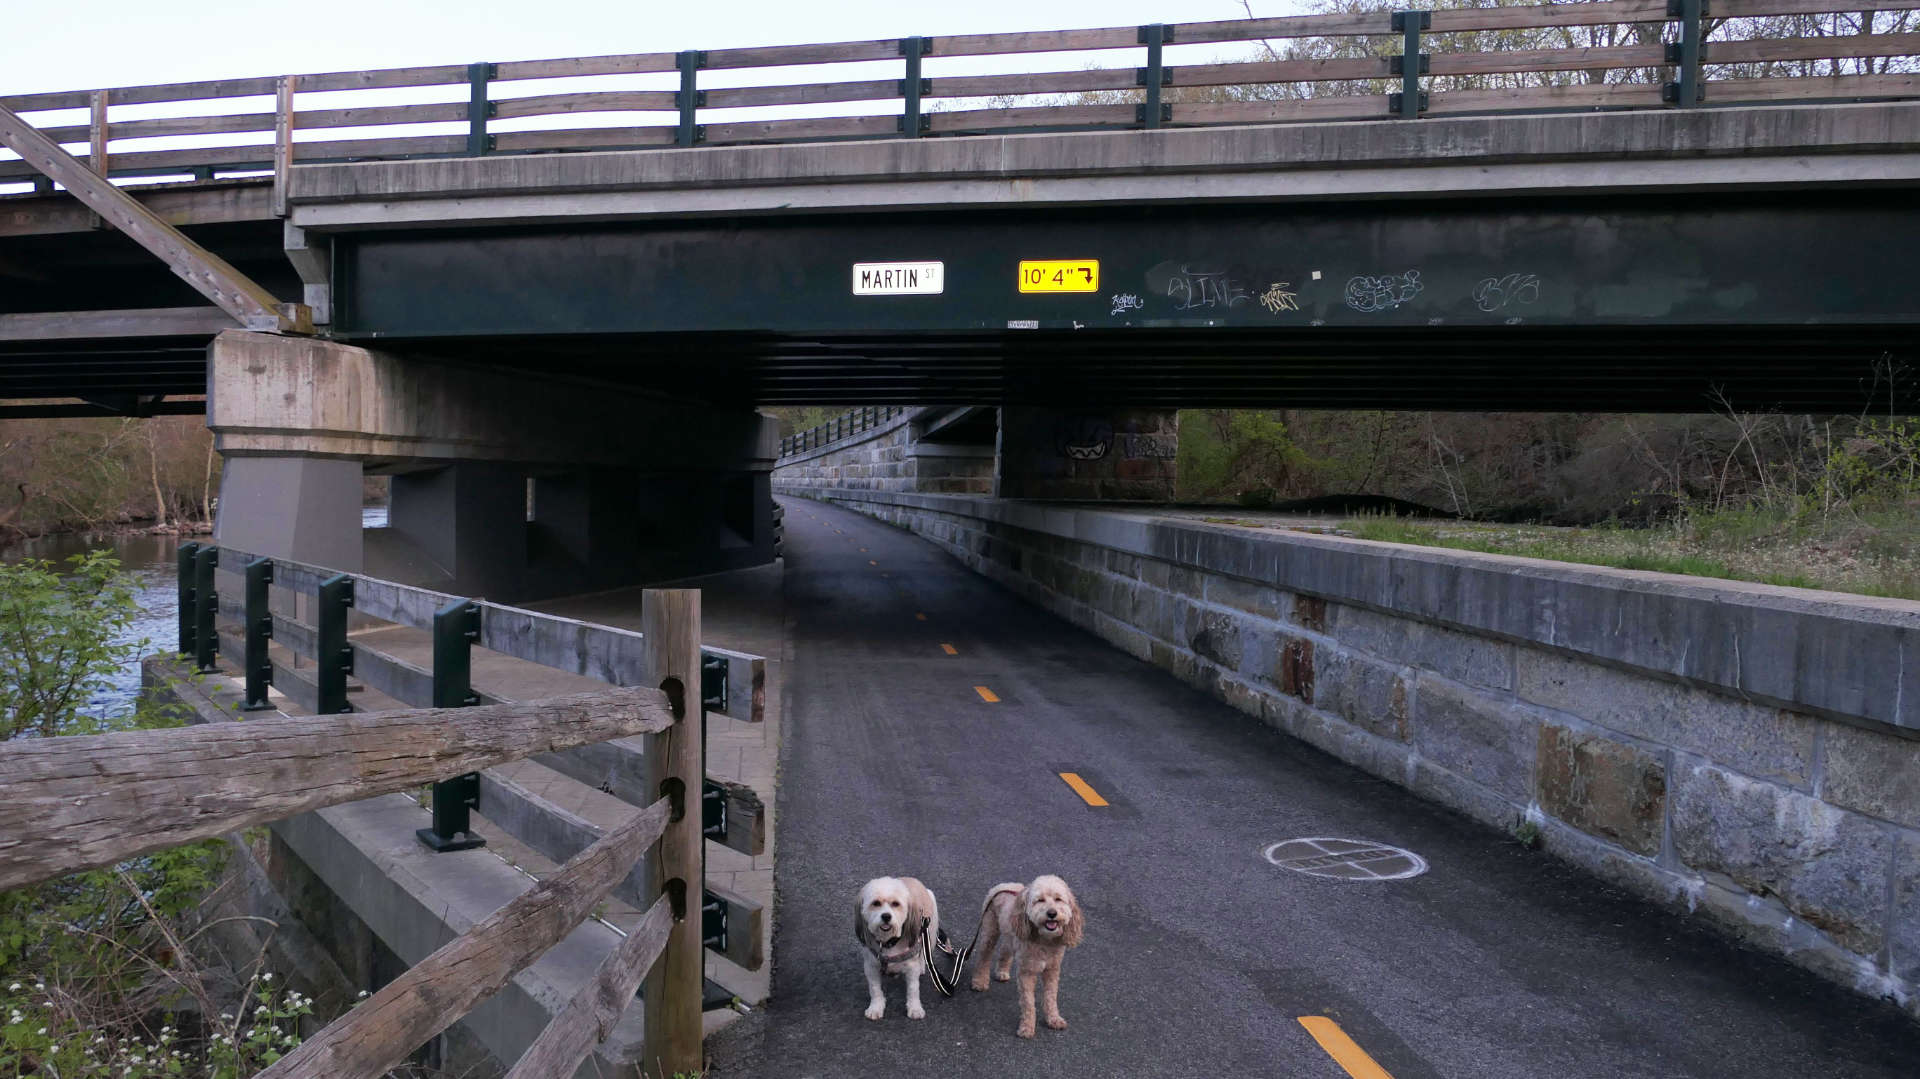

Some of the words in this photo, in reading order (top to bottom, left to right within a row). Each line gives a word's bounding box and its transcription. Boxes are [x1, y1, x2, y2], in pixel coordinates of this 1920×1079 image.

[862, 268, 918, 288] MARTIN
[925, 268, 936, 279] ST
[1024, 268, 1046, 285] 10'
[1051, 268, 1073, 286] 4"
